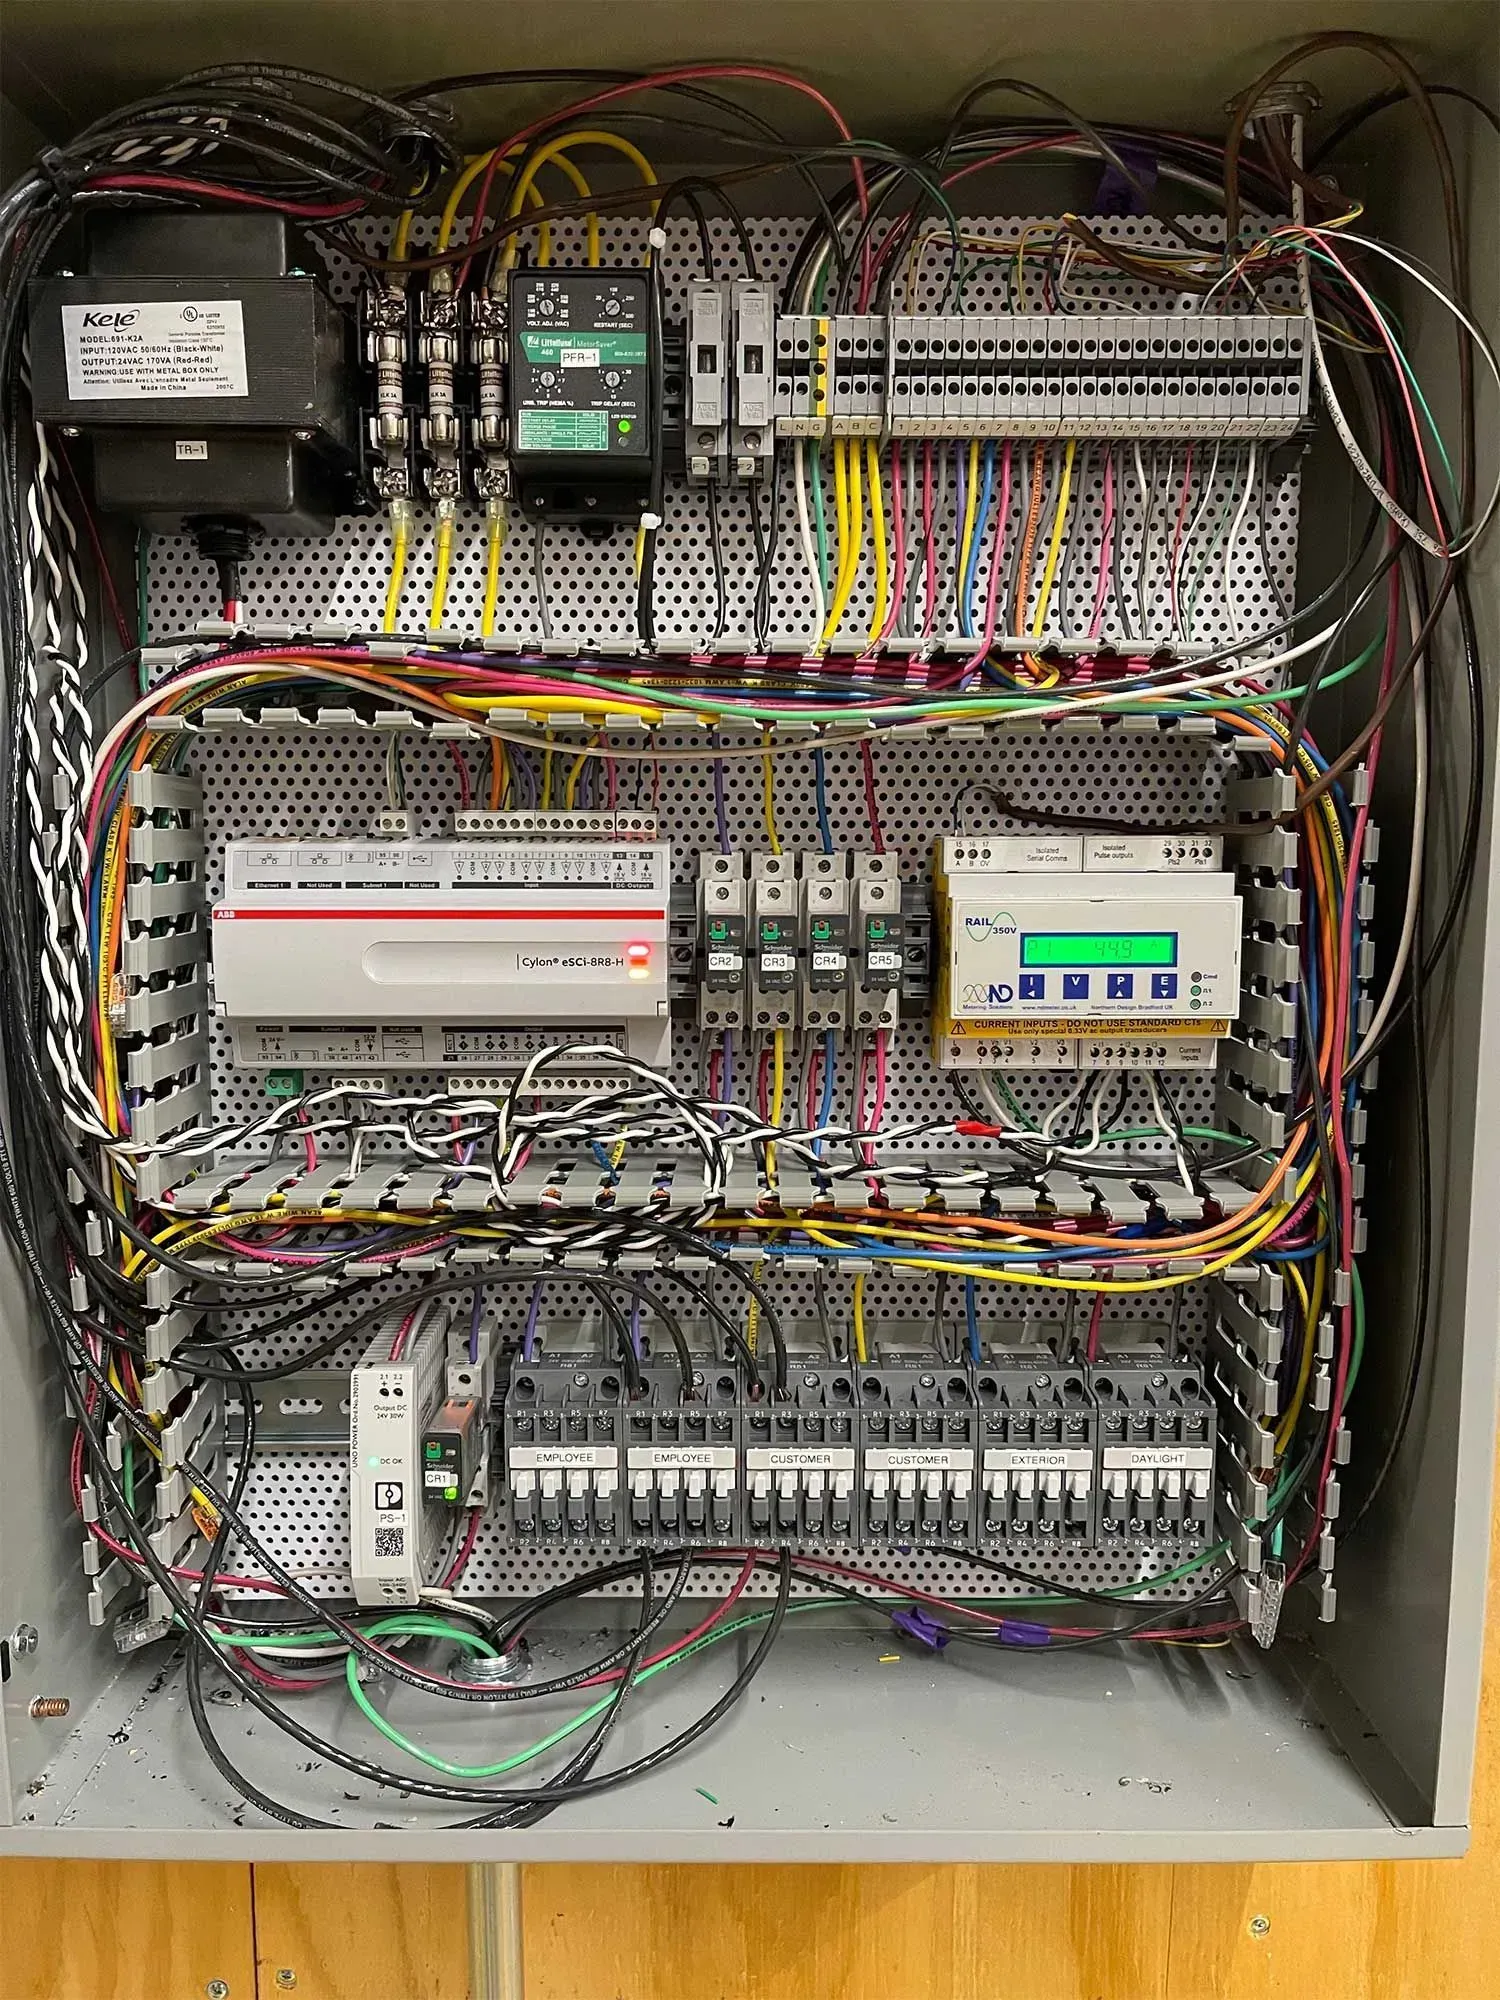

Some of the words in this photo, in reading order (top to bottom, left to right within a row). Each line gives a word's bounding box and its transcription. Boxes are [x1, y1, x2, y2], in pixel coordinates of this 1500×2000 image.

[83, 310, 138, 330] Kele
[80, 335, 143, 343] MODEL:691-K2A
[80, 346, 138, 355] INPUT:120VAC
[140, 345, 171, 353] 50/60Hz
[173, 344, 224, 353] (Black-White)
[81, 357, 143, 366] OUTPUT:24VAC
[146, 356, 171, 365] 170VA
[173, 355, 212, 365] (Red-Red)
[562, 352, 597, 363] PFR-1
[156, 367, 181, 375] METAL
[899, 423, 904, 432] 1
[914, 423, 921, 432] 2
[930, 423, 937, 432] 3
[946, 423, 953, 432] 4
[963, 423, 970, 432] 5
[979, 423, 986, 432] 6
[996, 423, 1003, 432] 7
[1013, 423, 1020, 432] 8
[1029, 423, 1036, 432] 9
[1044, 423, 1056, 432] 10
[1063, 423, 1074, 432] 11
[1079, 423, 1091, 432] 12
[1096, 423, 1108, 432] 13
[1112, 423, 1124, 432] 14
[1129, 423, 1141, 432] 15
[1145, 423, 1157, 432] 16
[1162, 423, 1174, 432] 17
[1179, 423, 1191, 432] 18
[1195, 423, 1207, 432] 19
[1211, 423, 1224, 432] 20
[1230, 423, 1243, 432] 21
[1246, 423, 1260, 432] 22
[1263, 423, 1278, 432] 23
[1280, 423, 1294, 432] 24
[177, 444, 204, 455] TR-1
[1111, 852, 1134, 860] outputs
[217, 911, 236, 919] ABB
[965, 917, 993, 926] RAIL
[992, 927, 1017, 935] 350V
[522, 957, 560, 969] Cylon®
[561, 957, 624, 967] eSCi-8R8-H
[710, 956, 733, 967] CR2
[763, 956, 786, 968] CR3
[815, 956, 838, 966] CR4
[869, 955, 893, 966] CR5
[1029, 976, 1034, 986] I
[1071, 976, 1081, 986] V
[1117, 976, 1125, 986] P
[1160, 976, 1169, 986] E
[974, 1020, 1020, 1029] CURRENT
[1023, 1020, 1058, 1028] INPUTS
[1067, 1019, 1081, 1028] DO
[1083, 1019, 1104, 1028] NOT
[1106, 1018, 1126, 1027] USE
[1128, 1018, 1182, 1027] STANDARD
[1184, 1018, 1202, 1027] CTs
[1023, 1028, 1039, 1036] only
[1178, 1046, 1202, 1054] Current
[373, 1404, 396, 1412] Output
[351, 1450, 359, 1469] UNO
[536, 1453, 593, 1463] EMPLOYEE
[654, 1453, 711, 1463] EMPLOYEE
[770, 1454, 831, 1464] CUSTOMER
[887, 1455, 949, 1465] CUSTOMER
[1011, 1455, 1066, 1465] EXTERIOR
[1131, 1454, 1185, 1464] DAYLIGHT
[426, 1474, 447, 1484] CR1
[380, 1513, 406, 1523] PS-1
